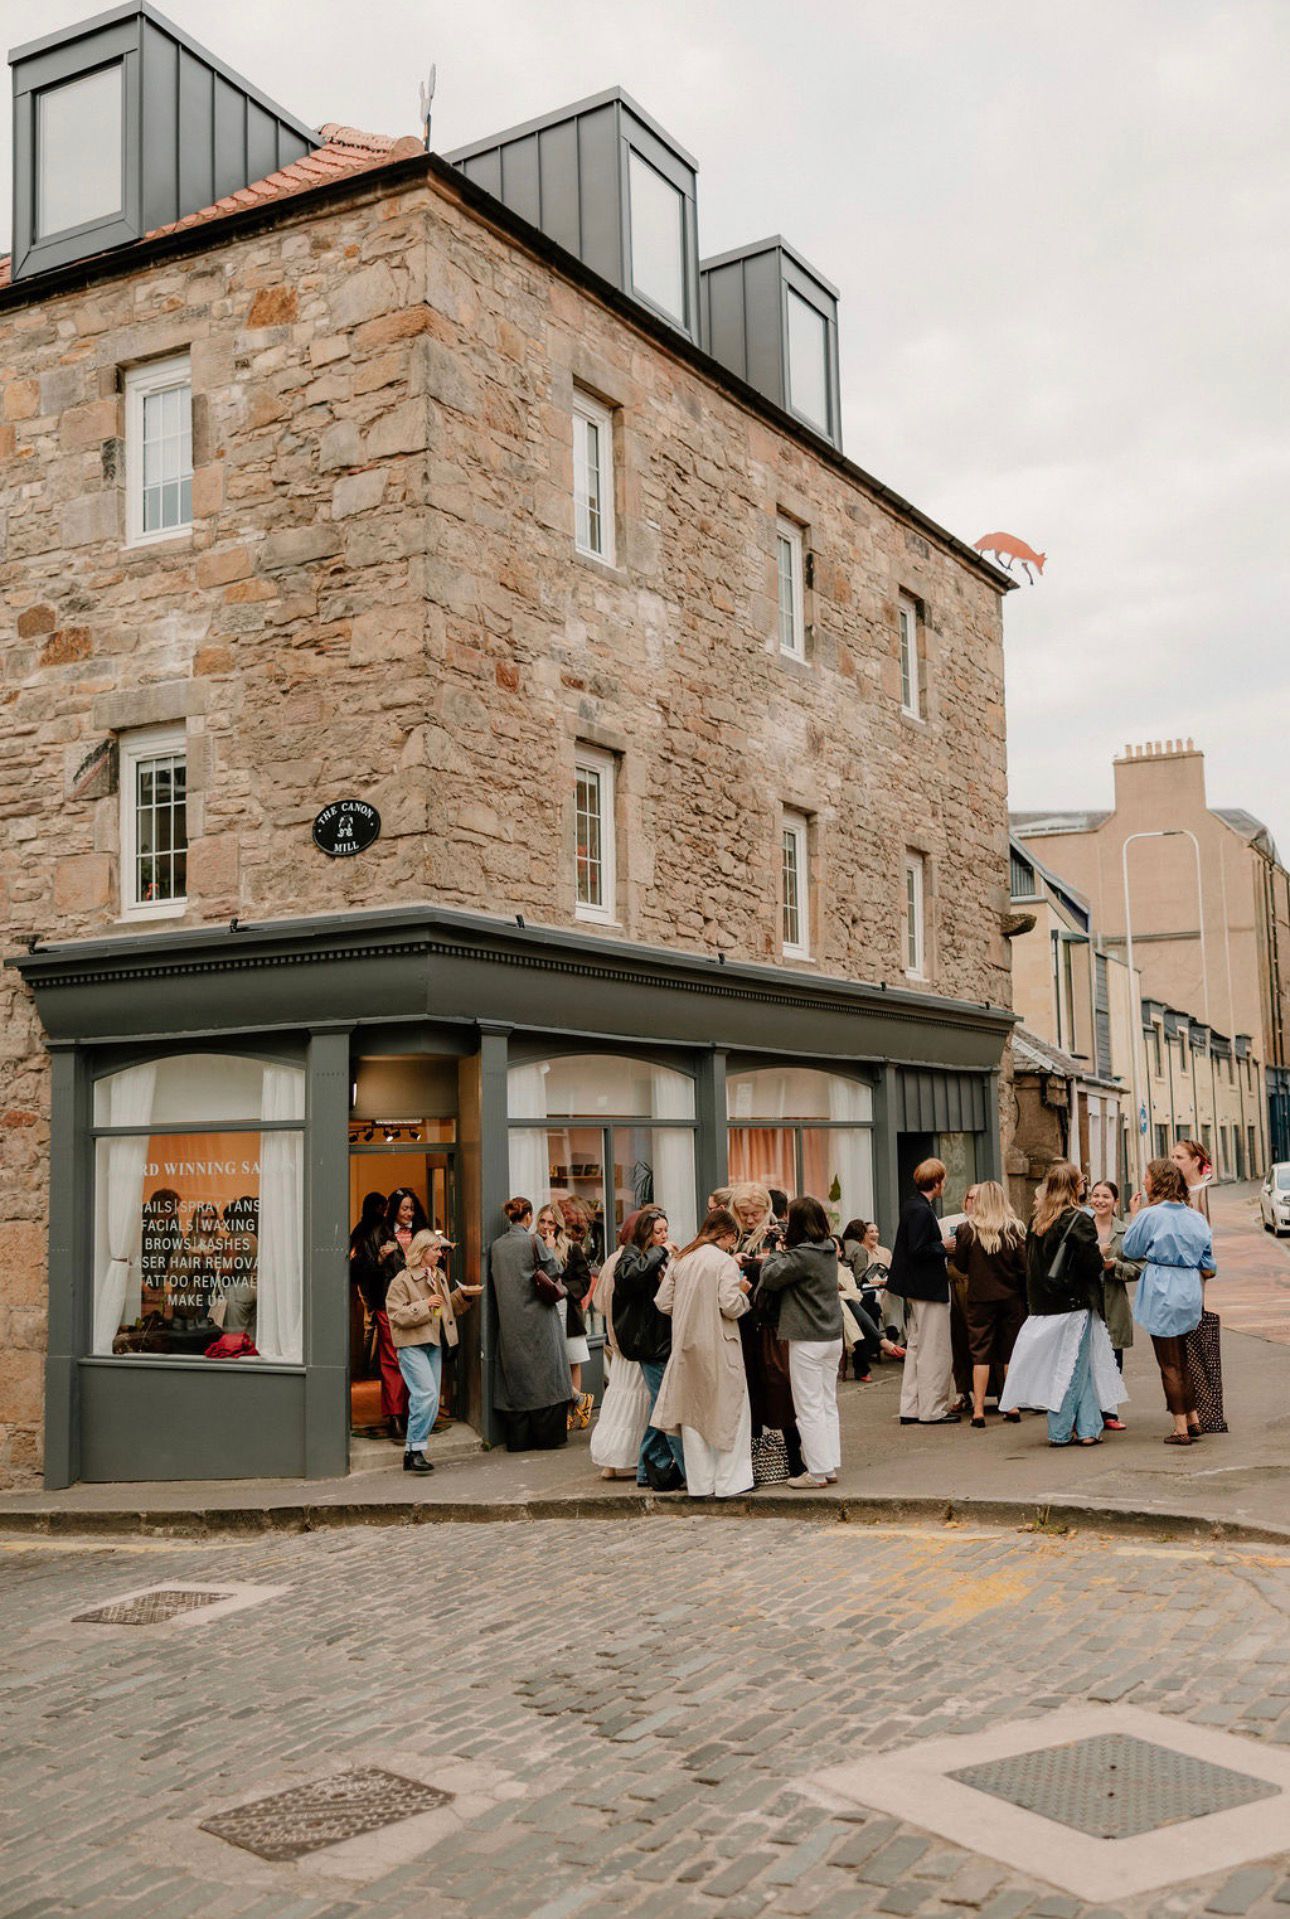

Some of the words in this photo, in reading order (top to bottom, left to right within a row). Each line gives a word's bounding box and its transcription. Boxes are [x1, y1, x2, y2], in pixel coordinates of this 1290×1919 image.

[317, 806, 338, 825] THE
[341, 802, 374, 819] CANON
[334, 841, 359, 852] MILL
[163, 1161, 237, 1176] WINNING
[179, 1200, 222, 1213] SPRAY
[227, 1199, 261, 1213] TANS
[141, 1219, 193, 1232] FACIALS
[201, 1218, 255, 1232] WAXING
[145, 1237, 191, 1251] BROWS
[169, 1256, 201, 1269] HAIR
[205, 1256, 261, 1269] REMOVA
[140, 1275, 189, 1288] TATTOO
[168, 1293, 203, 1307] MAKE
[207, 1293, 225, 1307] UP
